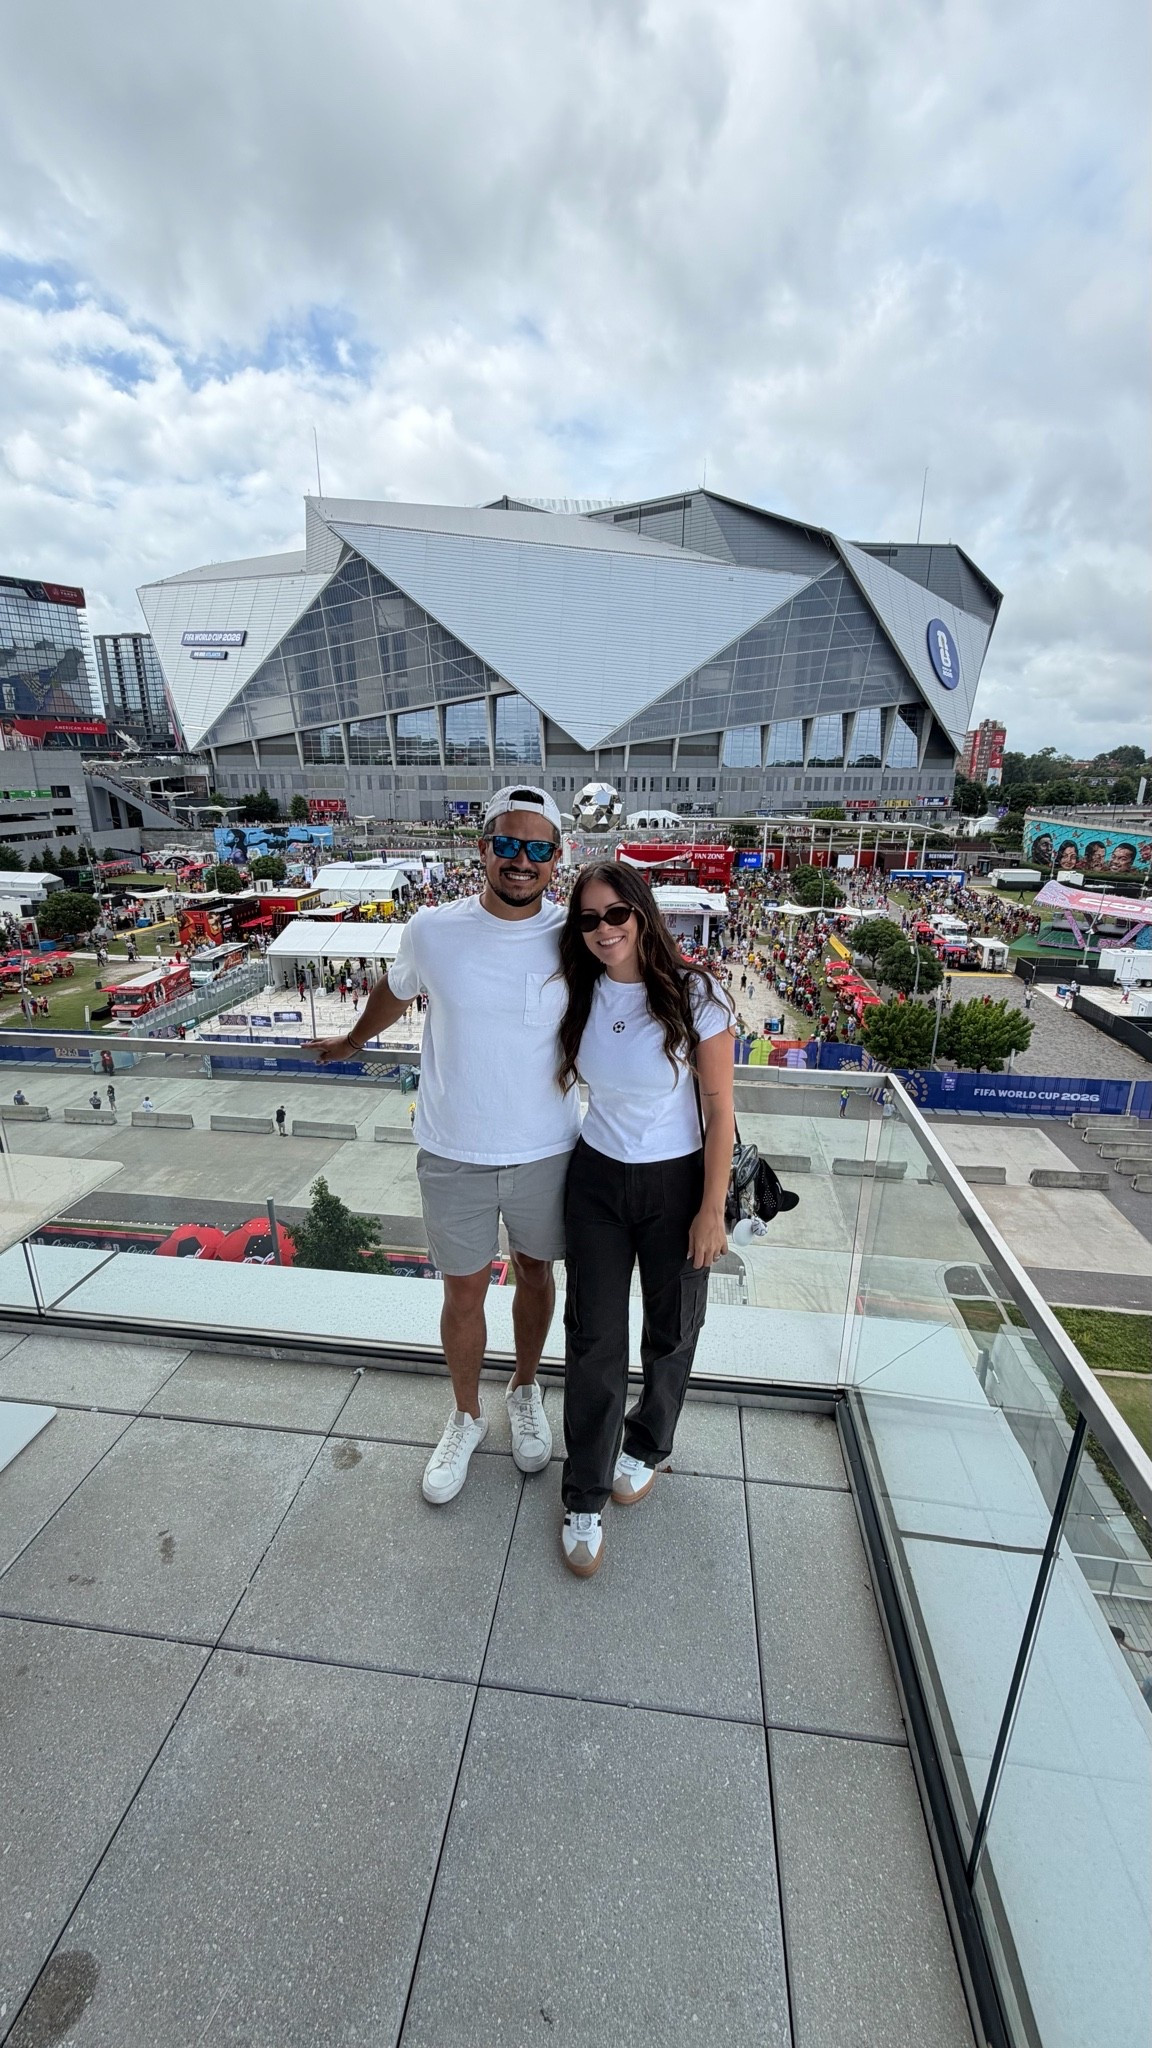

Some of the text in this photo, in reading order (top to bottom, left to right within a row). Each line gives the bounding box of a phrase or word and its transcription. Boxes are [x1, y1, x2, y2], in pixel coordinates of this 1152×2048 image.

[184, 633, 241, 642] FIFA WORLD CUP 2026
[30, 790, 37, 798] 5
[974, 1088, 1100, 1102] FIFA WORLD CUP 2026
